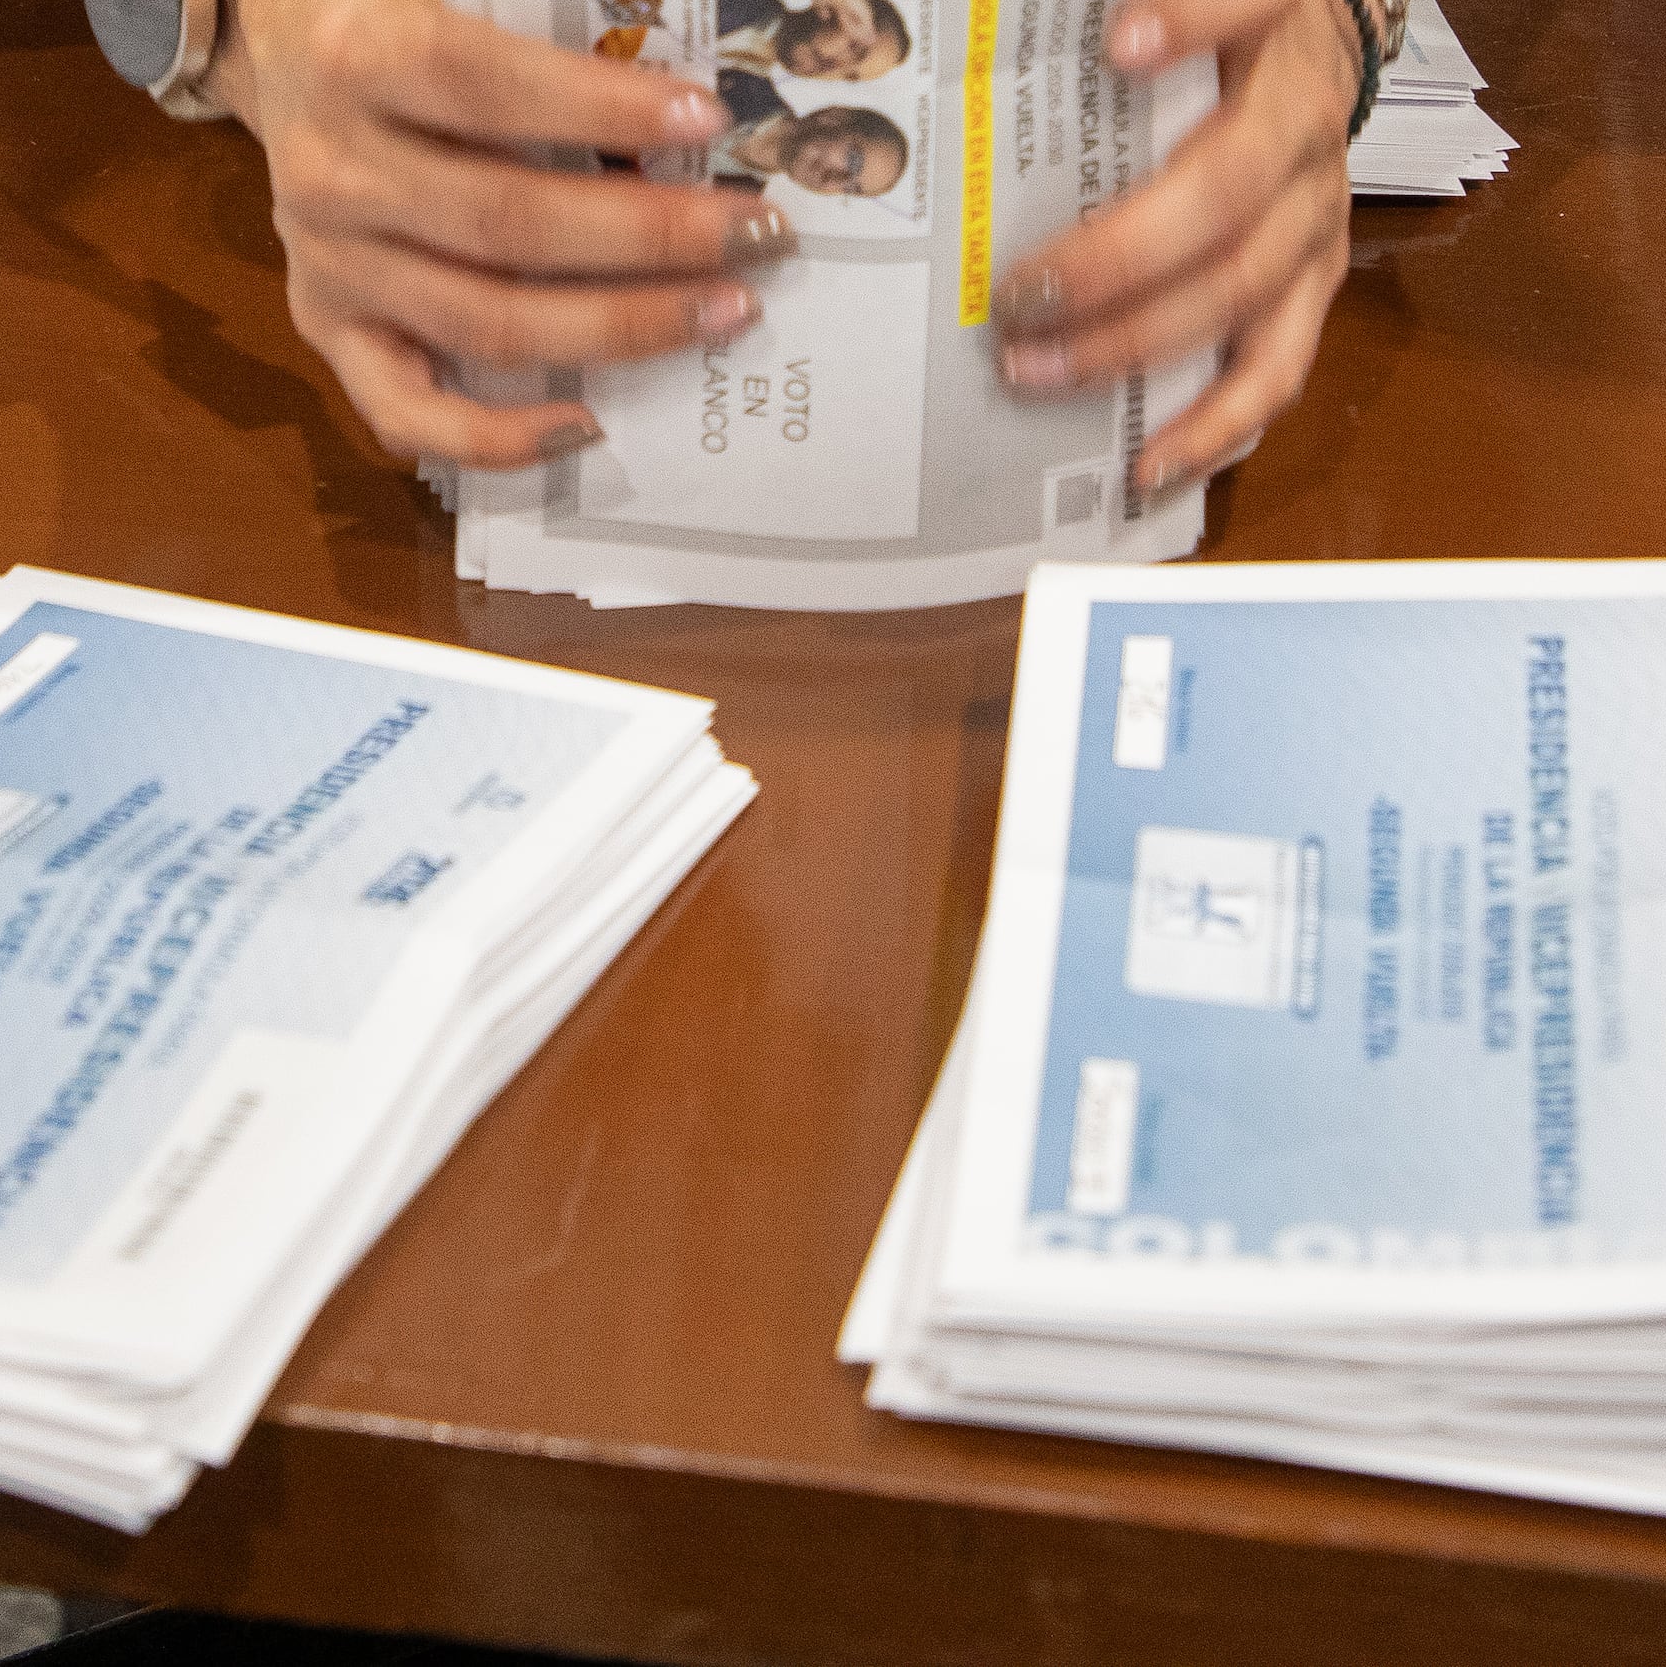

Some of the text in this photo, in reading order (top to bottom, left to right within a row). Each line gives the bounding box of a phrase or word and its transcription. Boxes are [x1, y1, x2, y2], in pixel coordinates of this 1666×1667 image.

[967, 170, 986, 220] ESTA
[1079, 160, 1101, 193] DE
[964, 227, 986, 318] TARJETA
[700, 350, 731, 455] LANCO
[743, 376, 771, 418] EN
[781, 357, 813, 443] VOTO
[1526, 636, 1583, 1228] PRESIDENCIA VICEPRESIDENCIA
